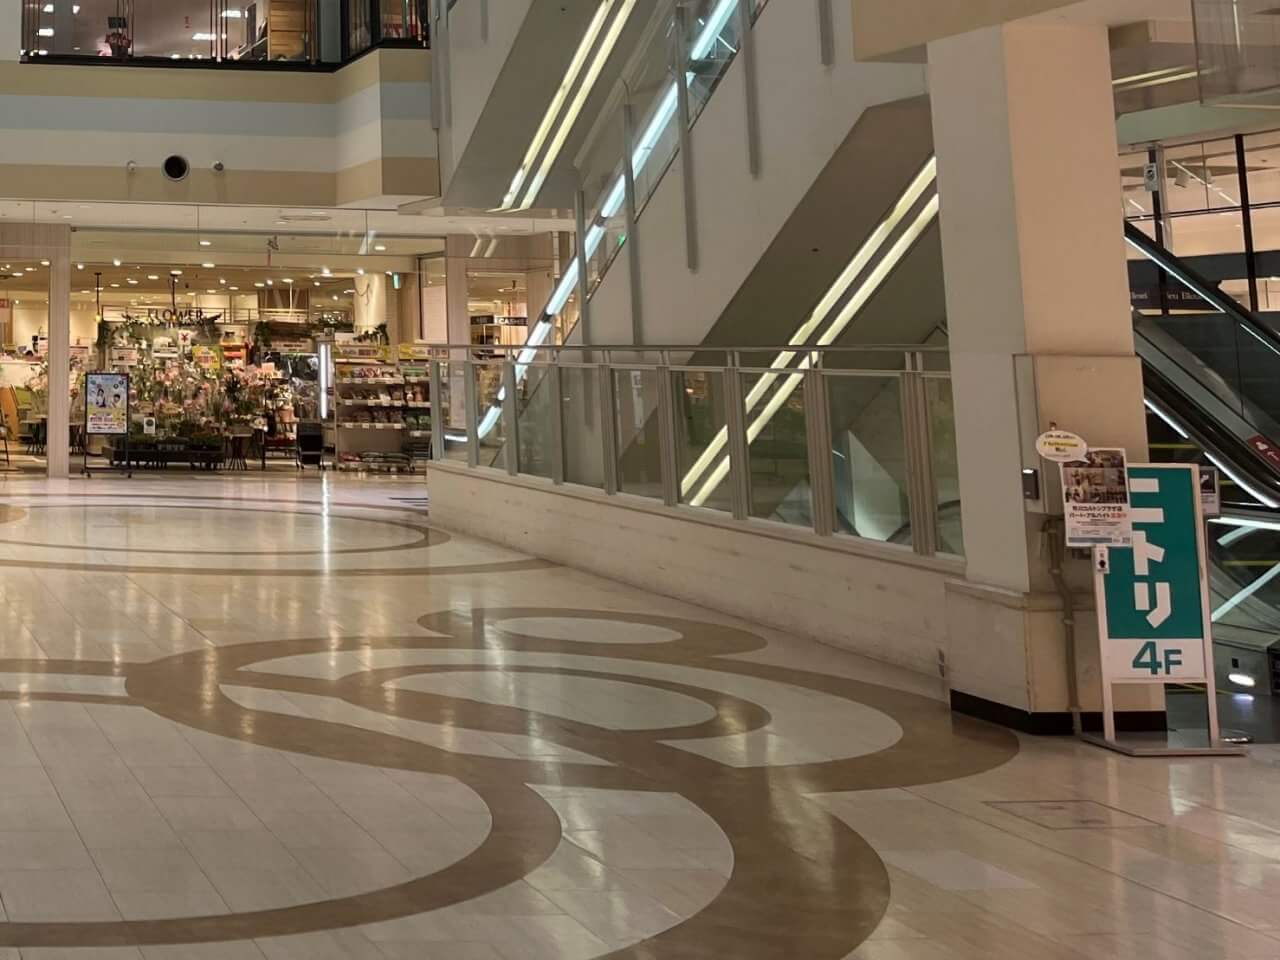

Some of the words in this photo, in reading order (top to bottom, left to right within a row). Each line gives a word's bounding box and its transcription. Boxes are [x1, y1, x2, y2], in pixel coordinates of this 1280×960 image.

[1128, 478, 1172, 629] ニトリ
[1132, 641, 1183, 675] 4F
